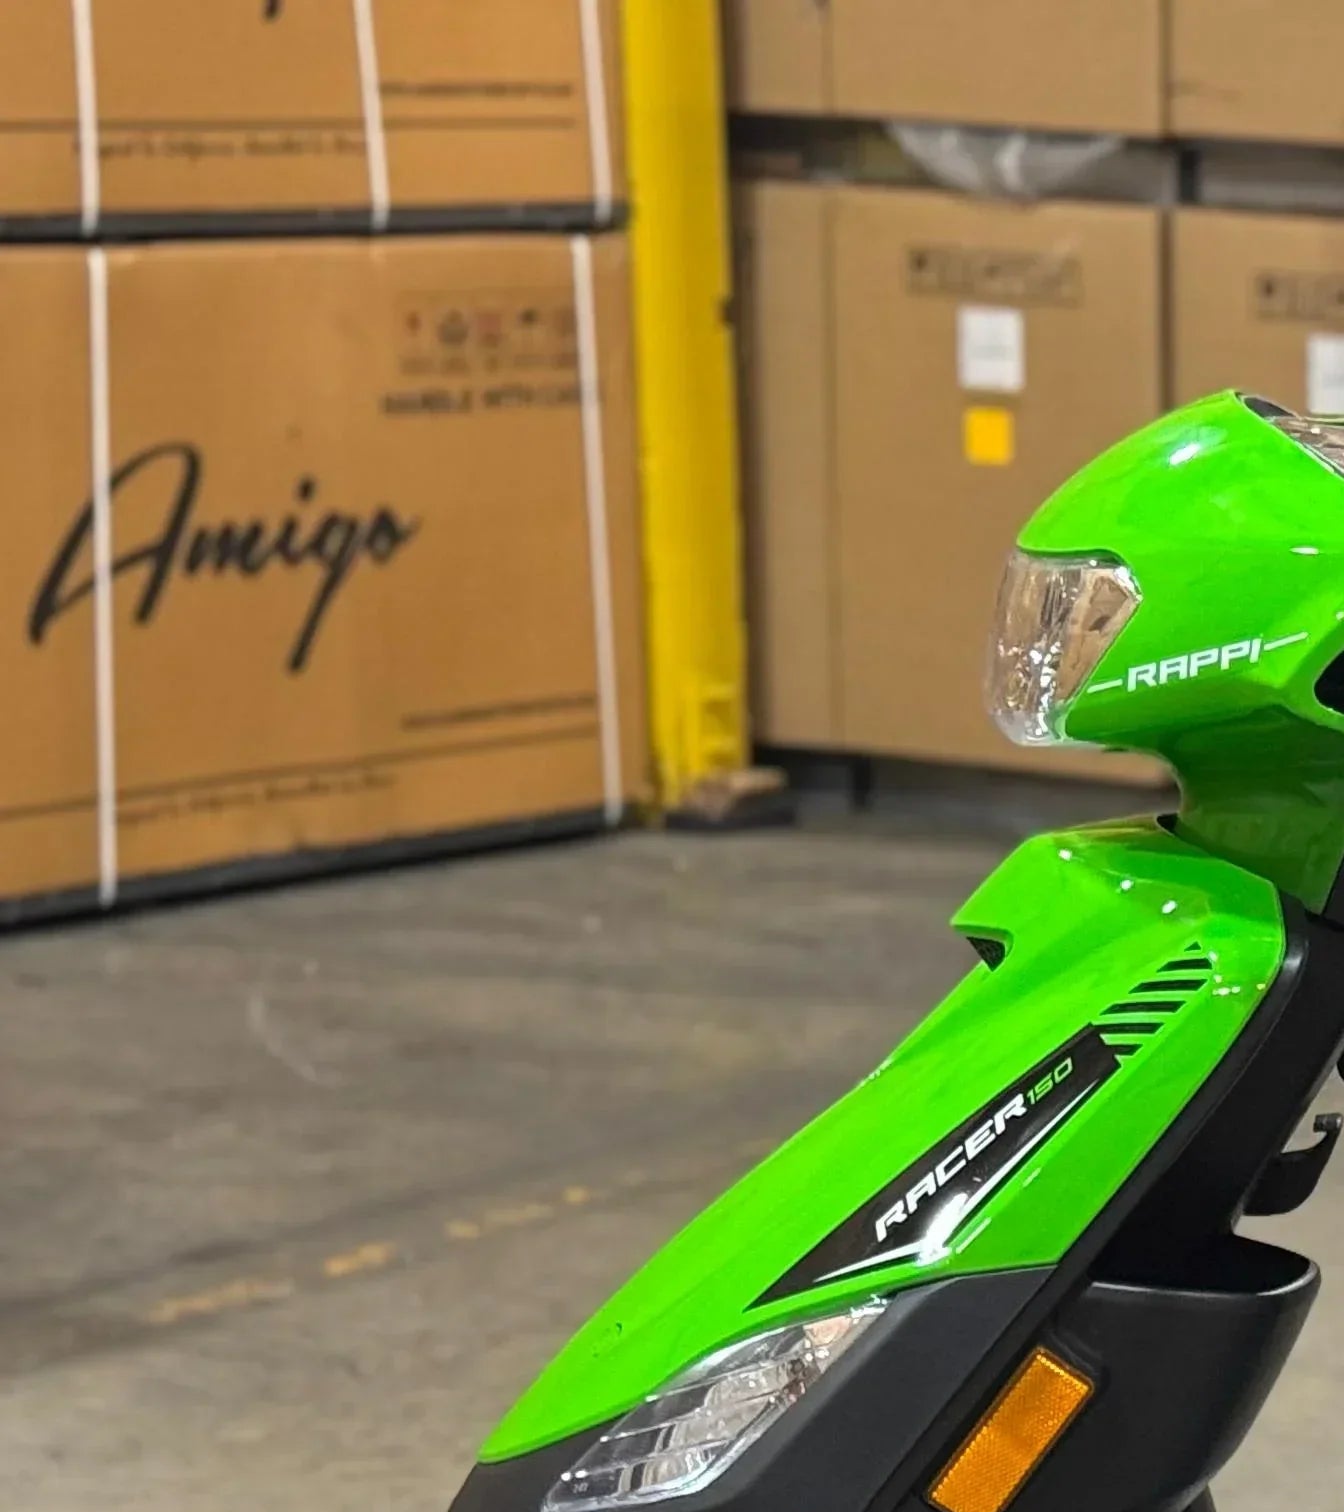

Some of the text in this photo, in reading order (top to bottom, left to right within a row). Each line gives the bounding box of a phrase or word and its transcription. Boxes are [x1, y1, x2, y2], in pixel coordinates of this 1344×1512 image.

[26, 440, 424, 676] Amigo
[1126, 637, 1263, 692] RAPPI
[874, 1056, 1073, 1243] RACER 150
